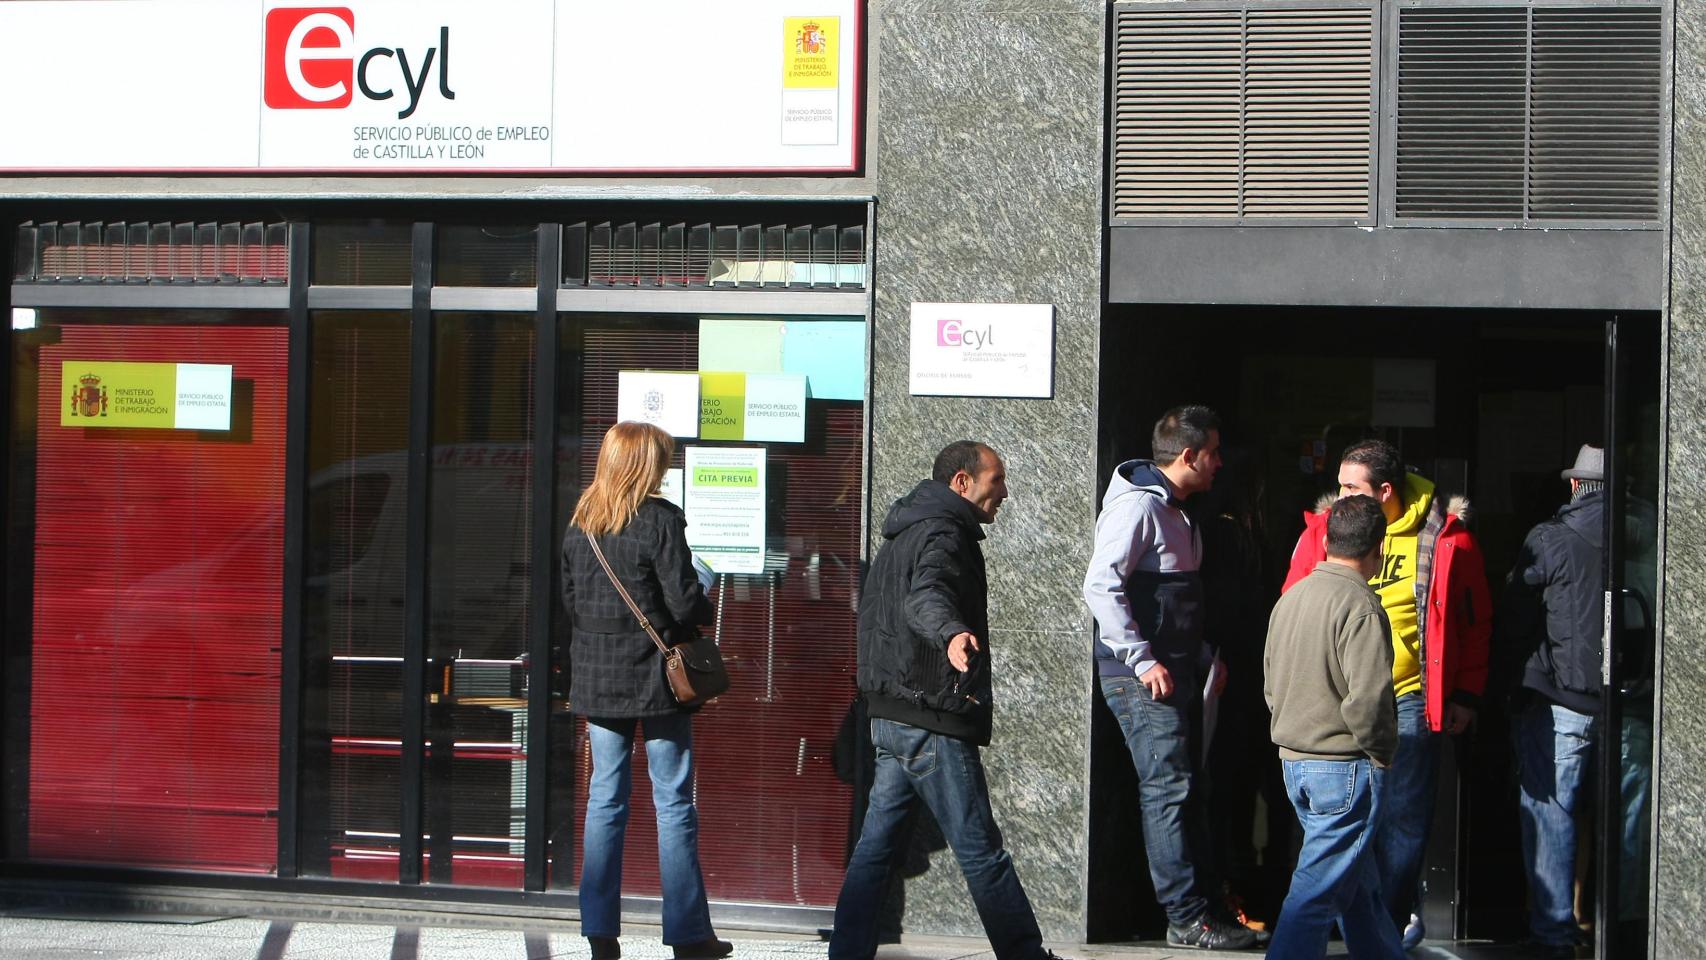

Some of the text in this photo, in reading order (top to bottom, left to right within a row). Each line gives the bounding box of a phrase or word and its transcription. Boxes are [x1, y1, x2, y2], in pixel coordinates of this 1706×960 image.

[284, 12, 455, 120] ecyl
[353, 123, 550, 141] SERVICIO PÚBLICO de EMPLEO
[353, 141, 484, 159] de CASTILLA Y LEÓN
[942, 320, 993, 350] ecyl
[115, 388, 154, 396] MINISTERIO
[126, 397, 156, 406] TRABAJO
[698, 474, 753, 483] CITA PREVIA
